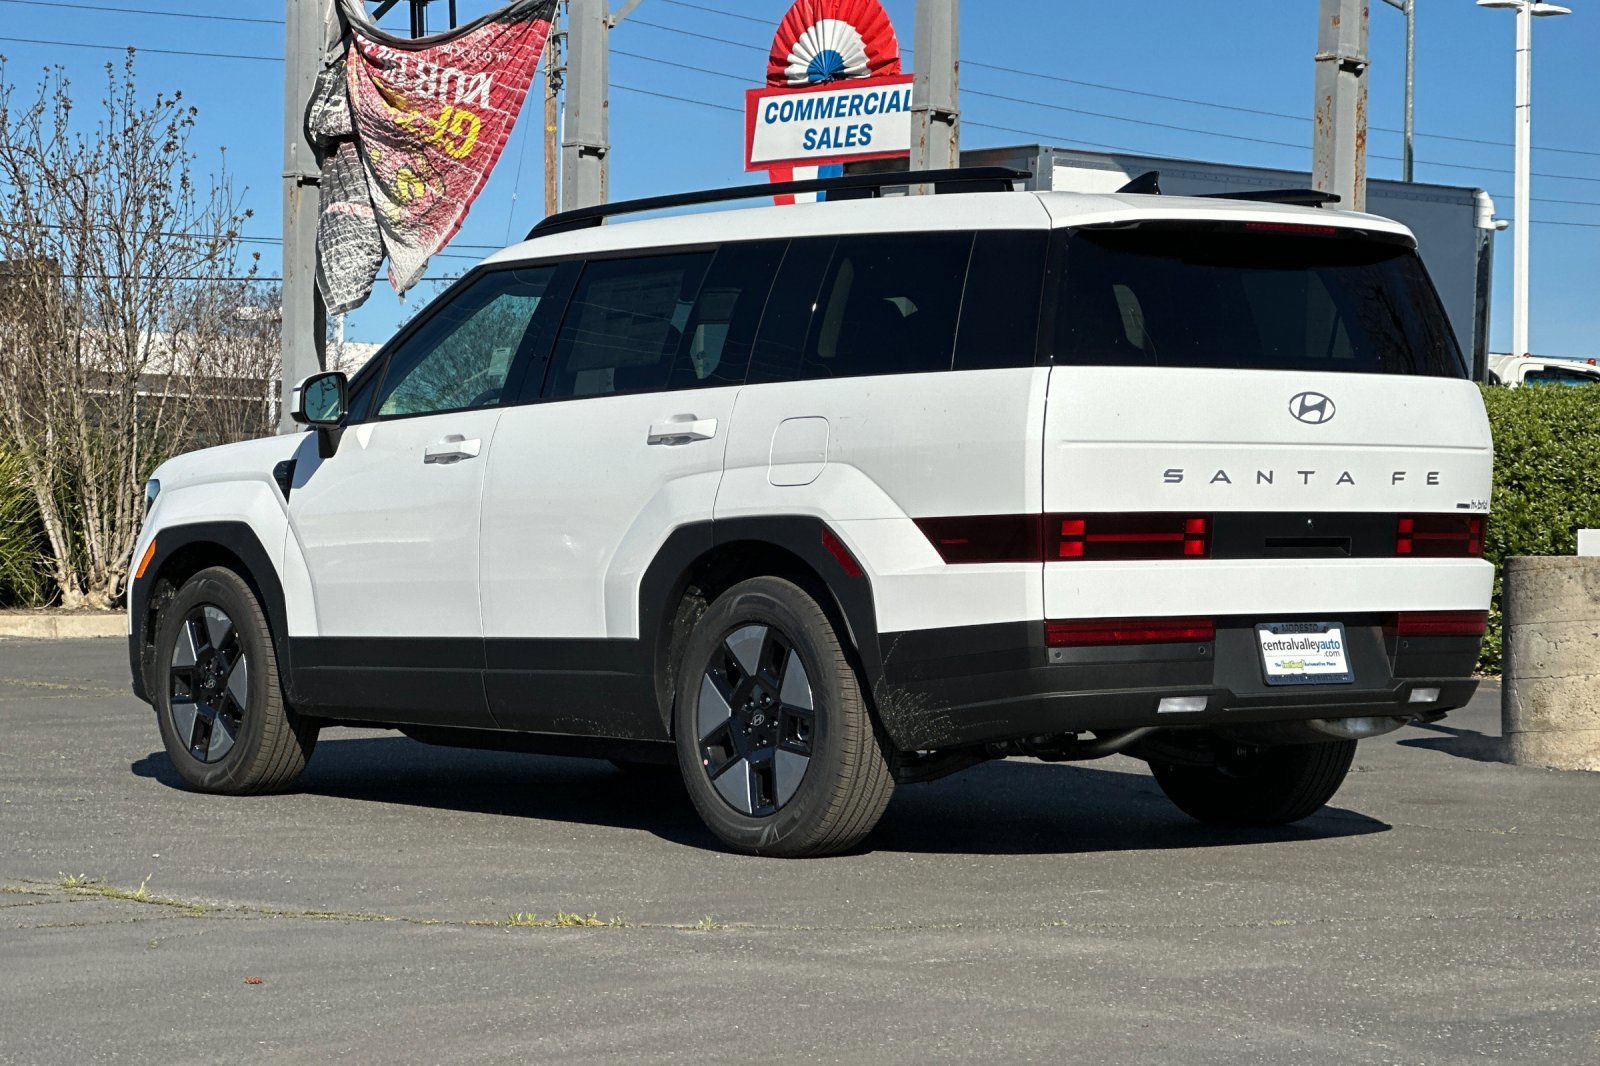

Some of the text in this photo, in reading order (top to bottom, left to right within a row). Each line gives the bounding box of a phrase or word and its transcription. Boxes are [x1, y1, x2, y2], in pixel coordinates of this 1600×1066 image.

[764, 89, 912, 124] COMMERCIAL
[803, 123, 873, 150] SALES
[1163, 469, 1440, 485] SANTA FE
[1281, 623, 1319, 632] MODESTO
[1262, 638, 1341, 653] centralvalleyauto
